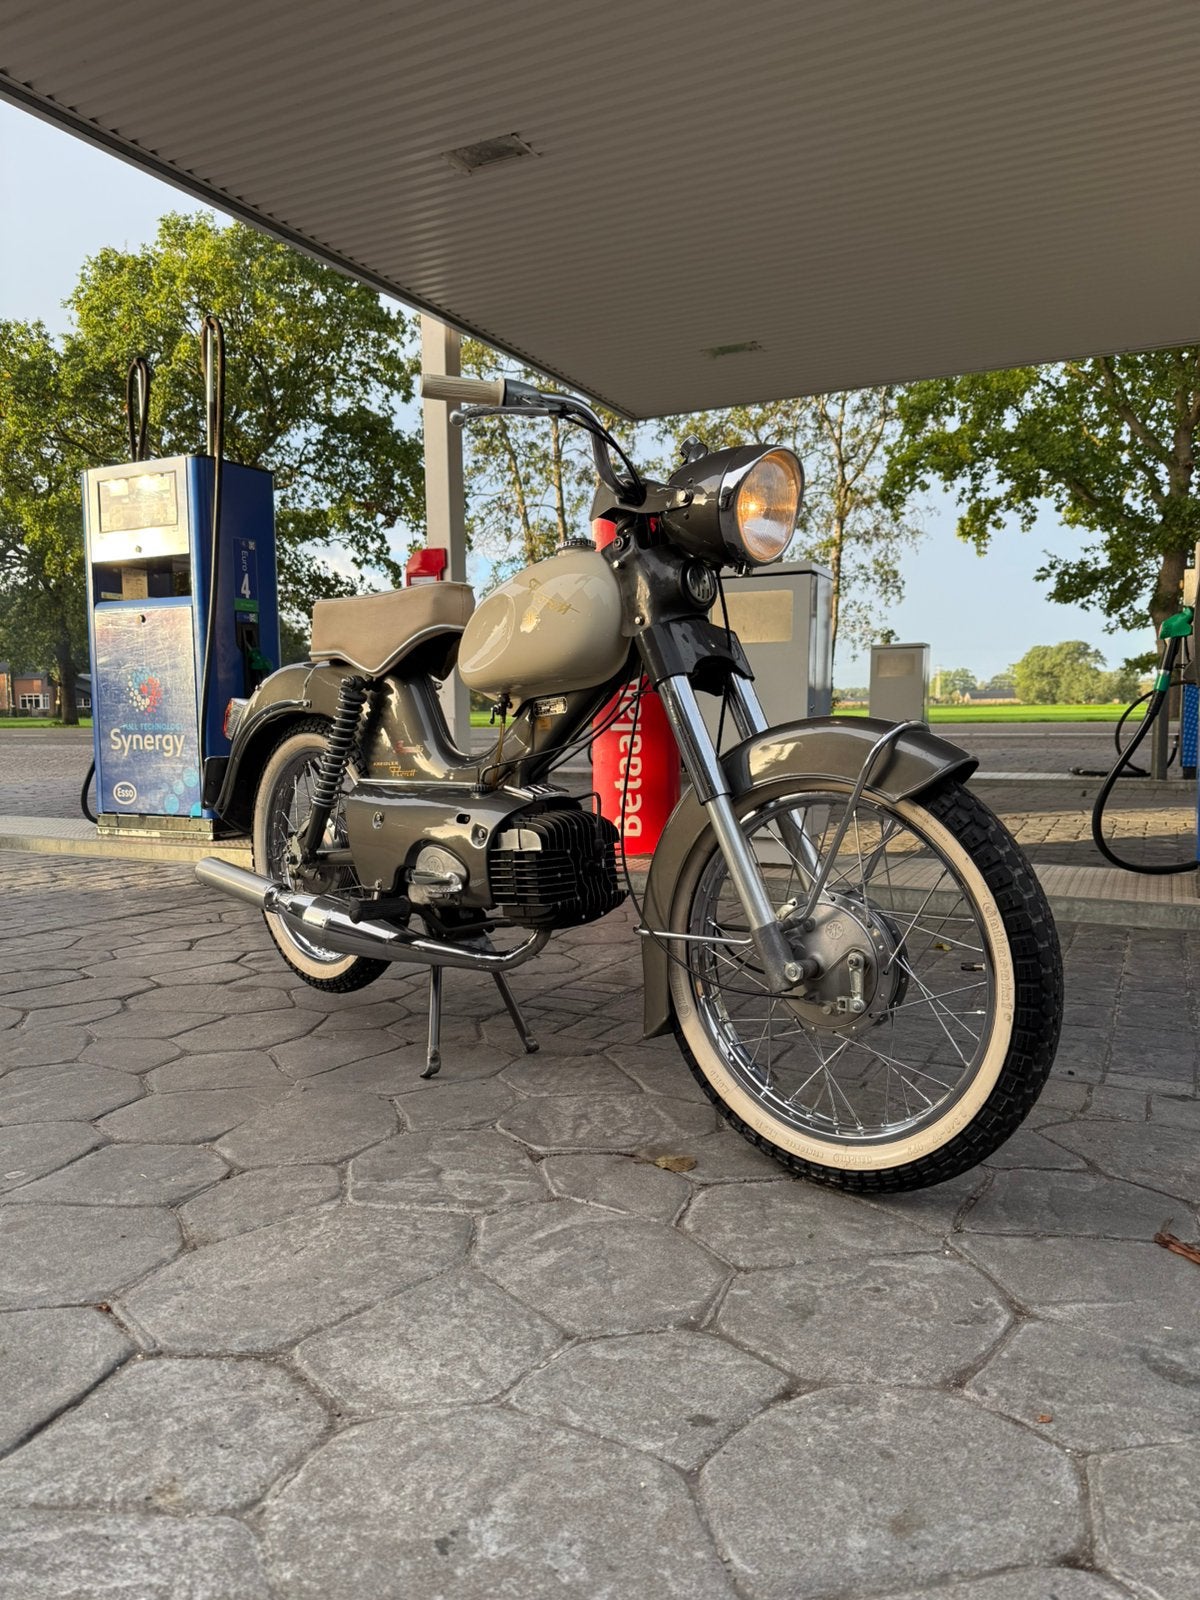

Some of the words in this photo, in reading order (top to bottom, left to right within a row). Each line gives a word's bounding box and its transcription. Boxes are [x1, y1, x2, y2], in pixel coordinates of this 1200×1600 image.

[241, 550, 249, 572] Euro
[240, 573, 251, 599] 4
[110, 727, 186, 757] Synergy
[116, 787, 135, 798] Esso
